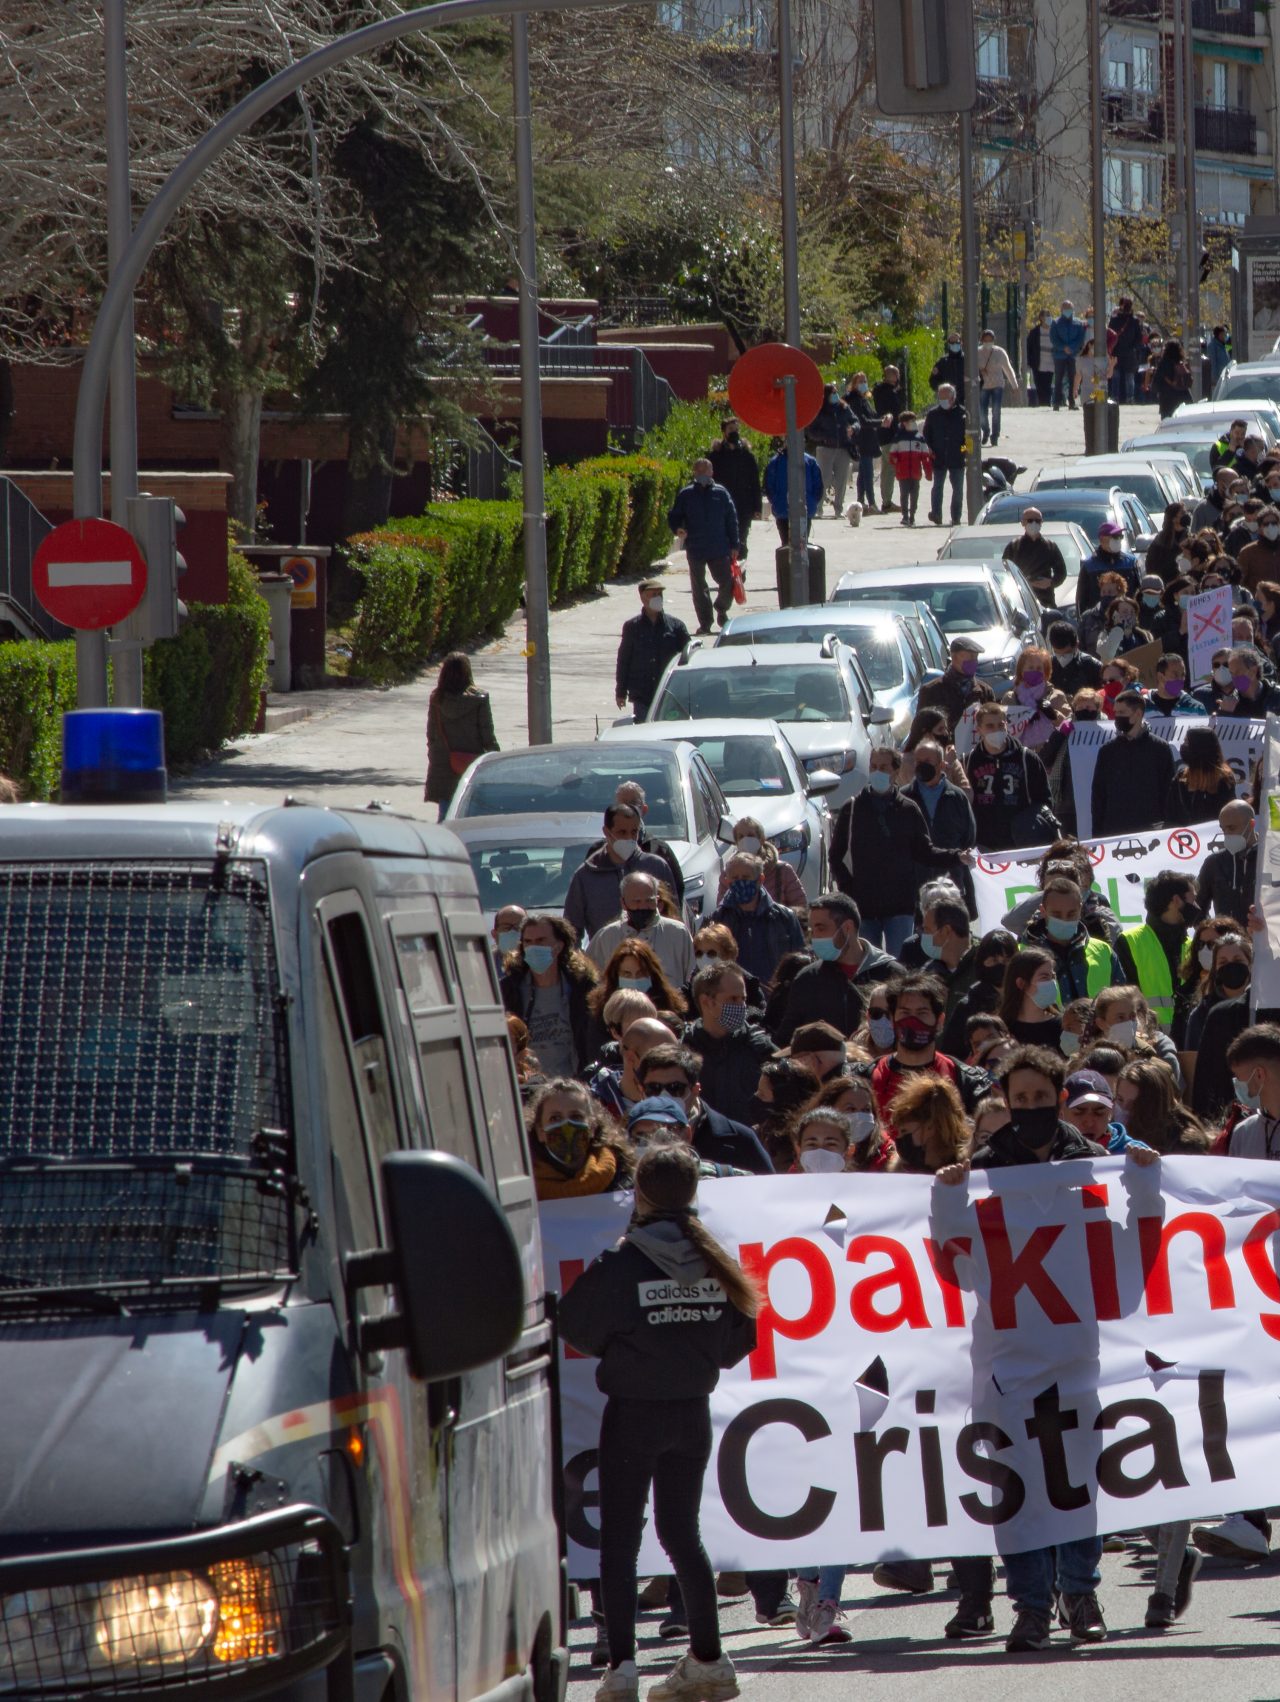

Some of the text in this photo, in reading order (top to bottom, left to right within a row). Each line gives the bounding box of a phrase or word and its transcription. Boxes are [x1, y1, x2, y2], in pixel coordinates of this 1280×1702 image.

[646, 1284, 700, 1301] adidas
[647, 1306, 702, 1325] adidas
[717, 1369, 1236, 1540] Cristal
